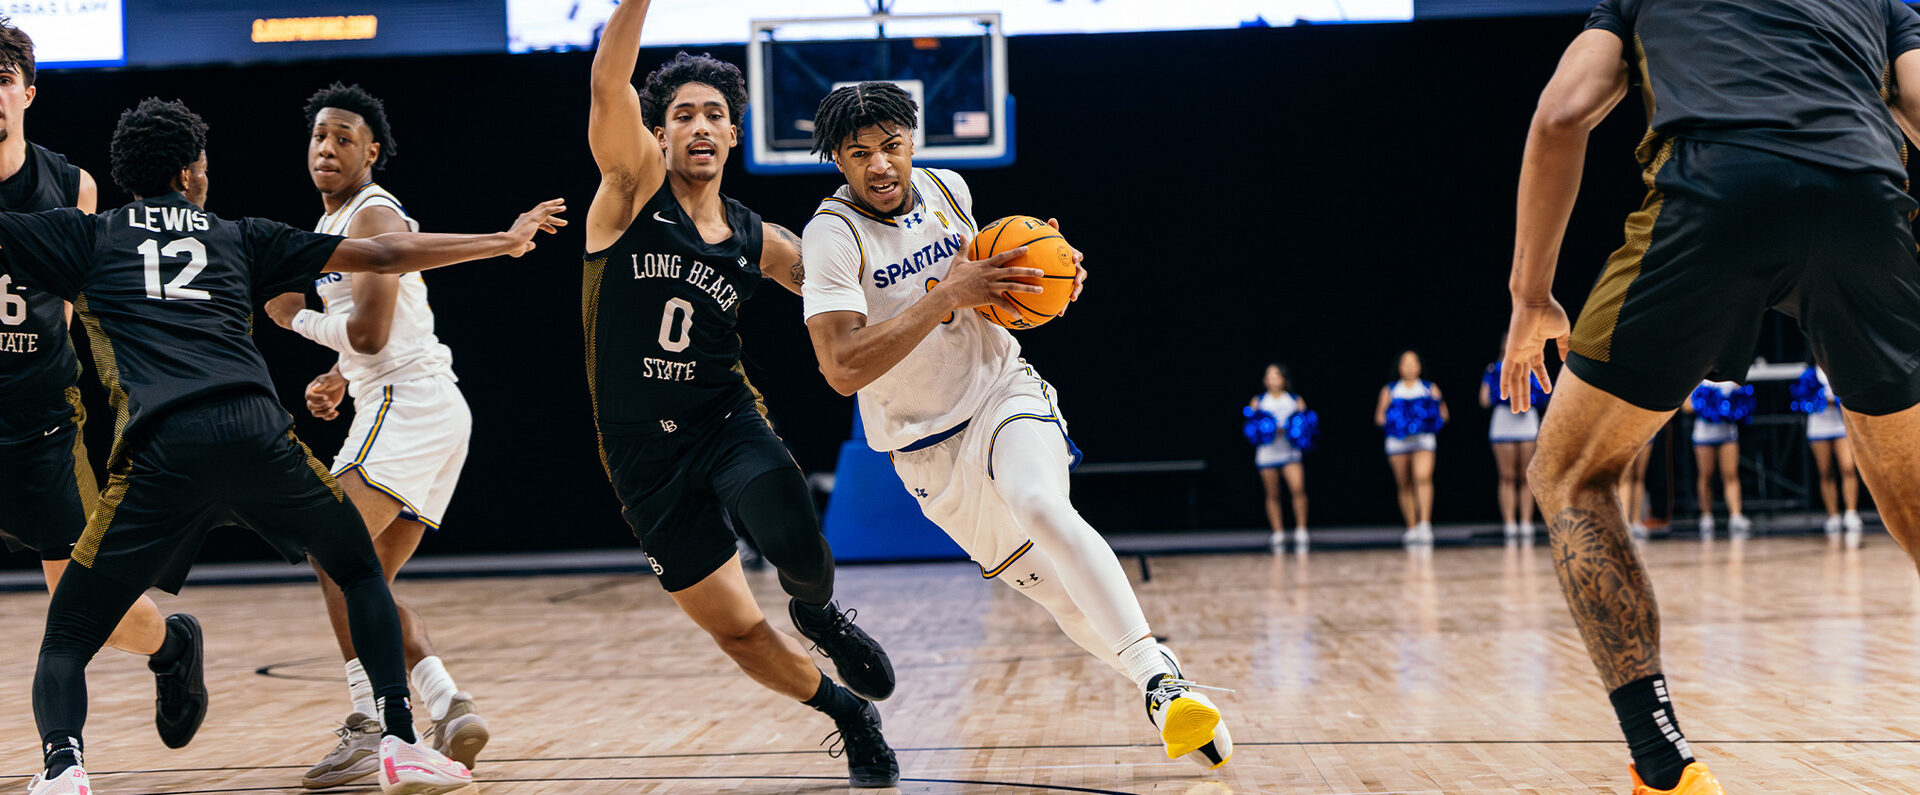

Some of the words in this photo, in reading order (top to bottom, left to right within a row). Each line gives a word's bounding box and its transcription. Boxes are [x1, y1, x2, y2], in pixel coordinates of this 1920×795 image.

[128, 206, 209, 232] LEWIS
[137, 236, 211, 300] 12
[631, 253, 682, 279] LONG
[685, 260, 738, 312] BEACH
[873, 233, 961, 288] SPARTAN
[658, 297, 694, 353] 0
[643, 357, 696, 381] STATE
[659, 419, 678, 433] LB
